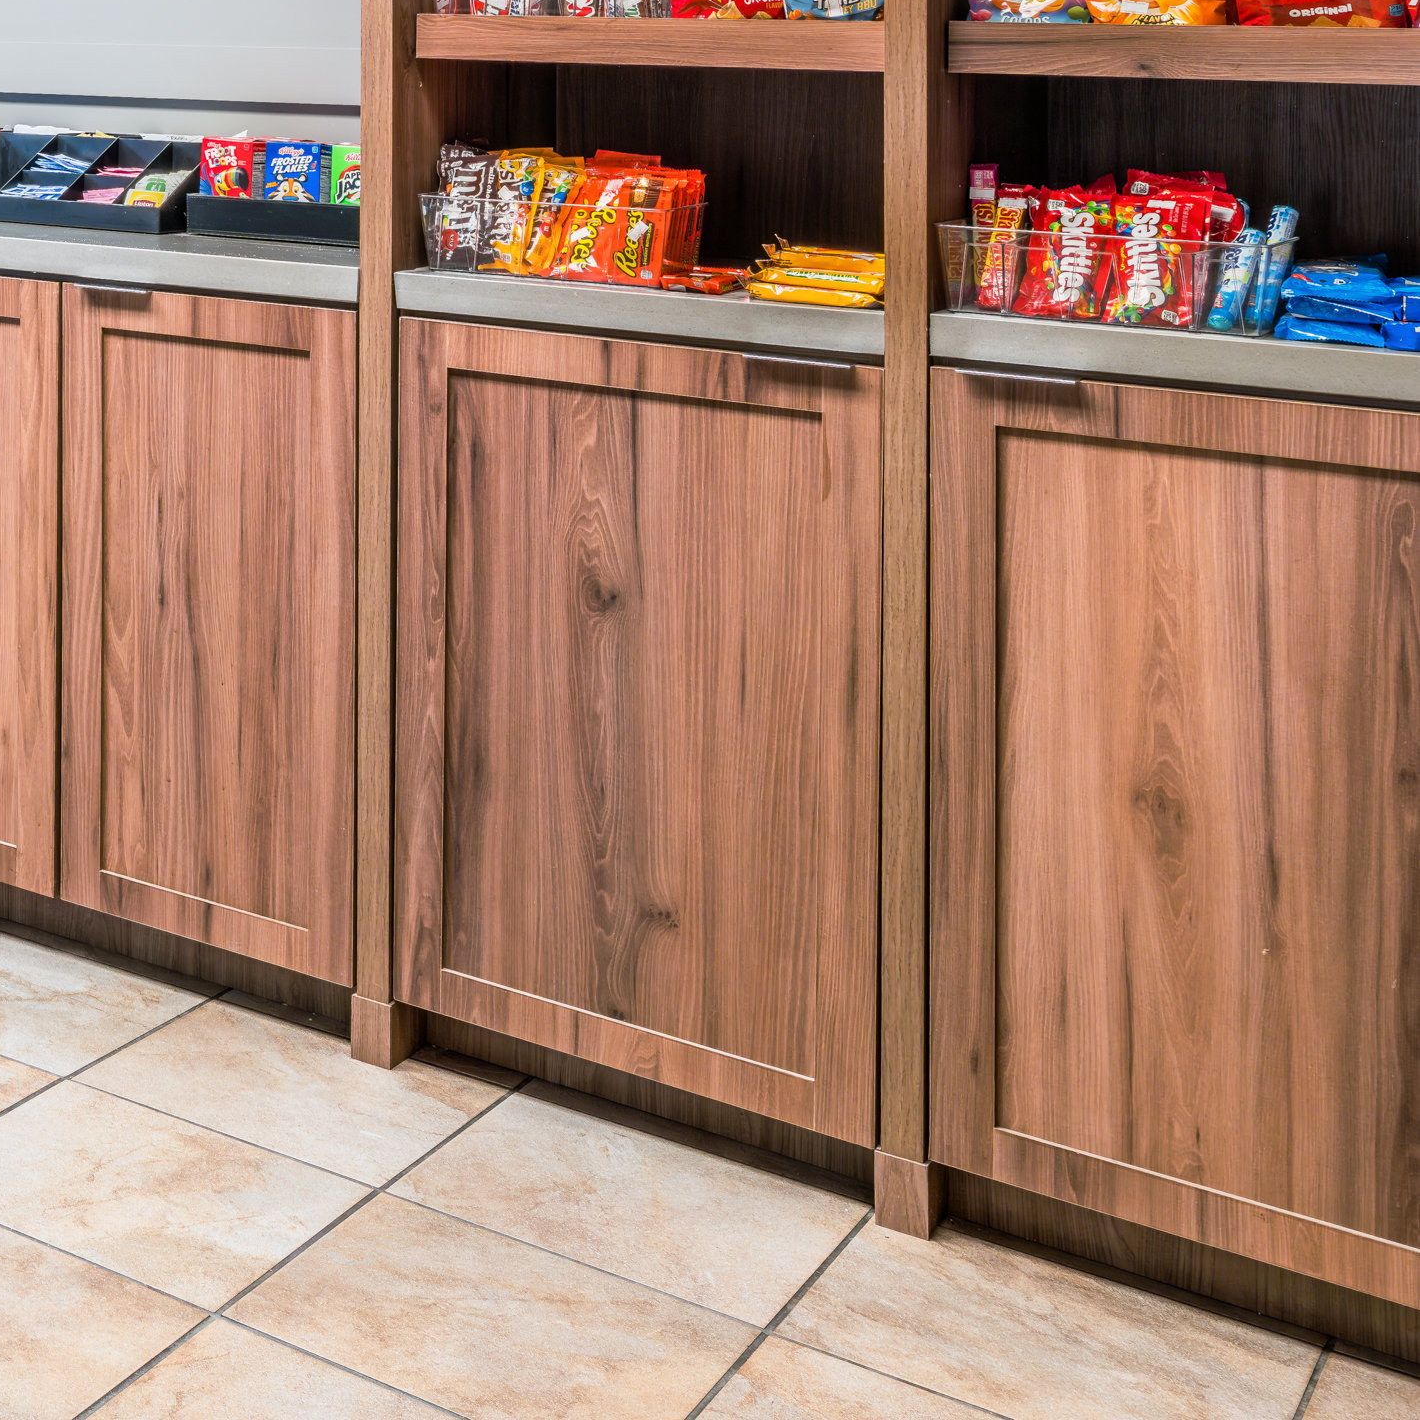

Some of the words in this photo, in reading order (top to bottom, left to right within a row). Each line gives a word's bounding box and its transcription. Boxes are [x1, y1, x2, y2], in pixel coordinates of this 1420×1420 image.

[204, 146, 237, 160] FROOT
[208, 156, 238, 169] LOOPS
[270, 155, 313, 167] FROSTED
[272, 164, 309, 175] FLAKES
[1052, 211, 1096, 303] Skittles
[1125, 209, 1166, 307] Skittles
